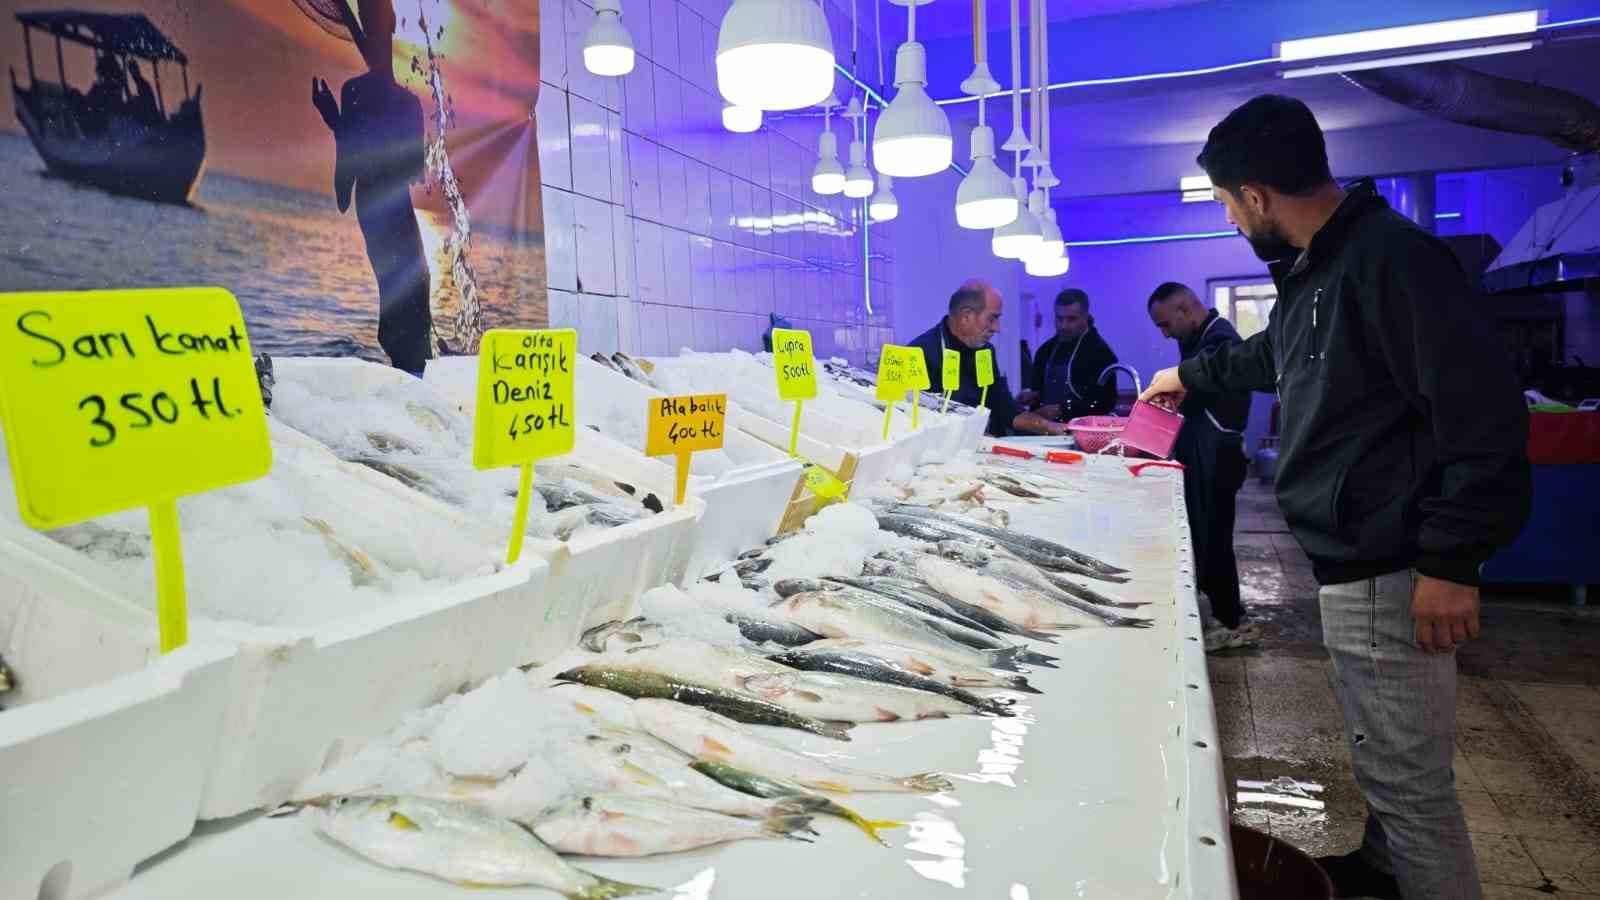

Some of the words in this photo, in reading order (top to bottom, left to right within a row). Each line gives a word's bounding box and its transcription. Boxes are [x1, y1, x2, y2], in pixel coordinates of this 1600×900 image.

[17, 310, 137, 368] Sarı
[491, 340, 569, 377] Karışık
[492, 379, 553, 405] Deniz
[77, 393, 180, 448] 350
